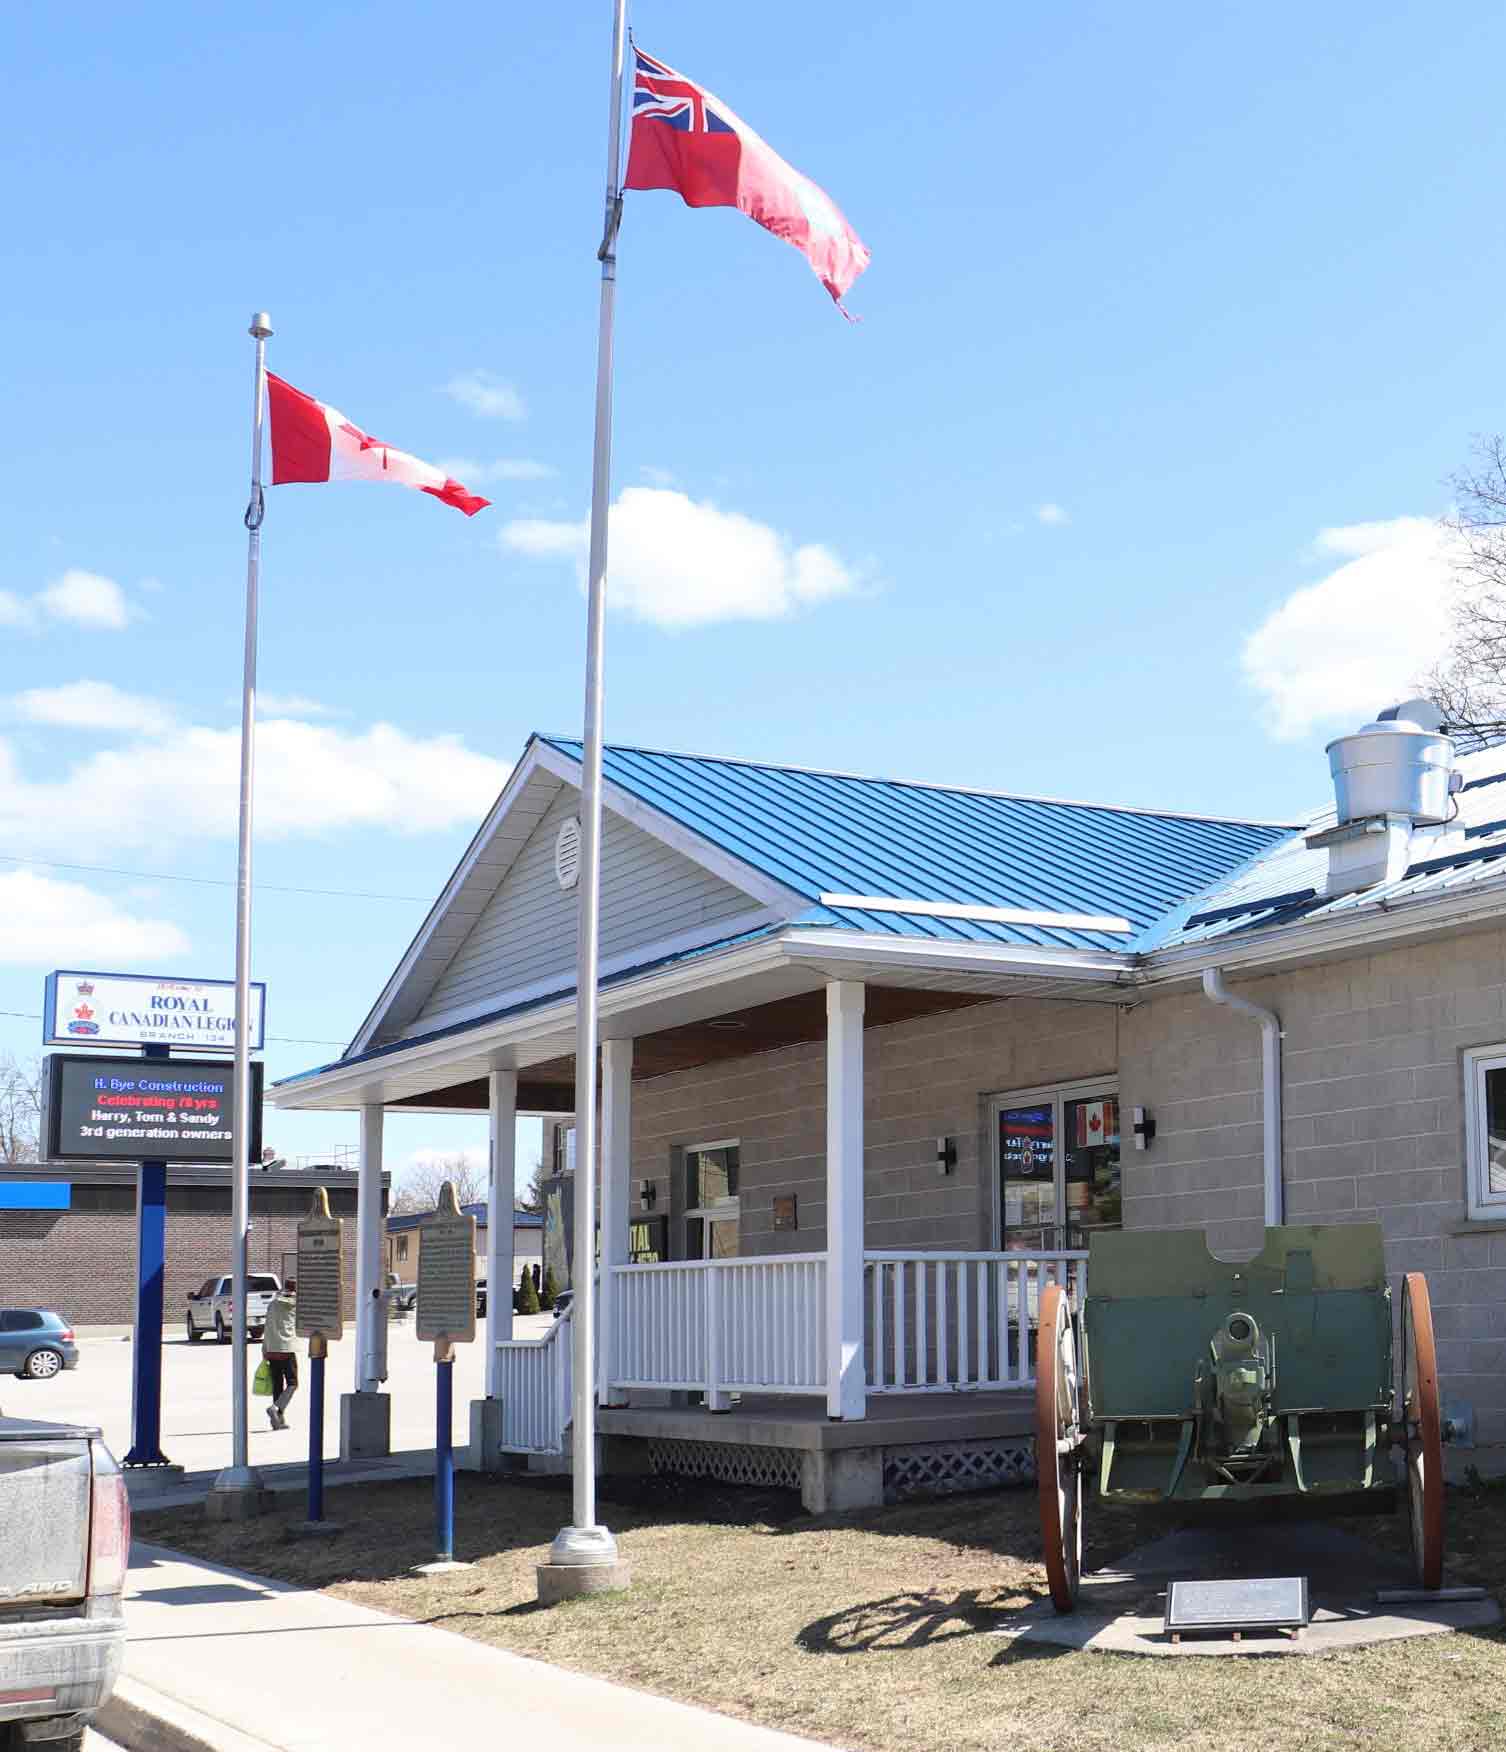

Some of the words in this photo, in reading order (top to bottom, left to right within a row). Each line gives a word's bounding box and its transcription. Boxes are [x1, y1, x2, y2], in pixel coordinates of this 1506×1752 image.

[151, 995, 213, 1012] ROYAL
[109, 1010, 193, 1029] CANADIAN
[197, 1015, 253, 1031] LEGI
[139, 1031, 194, 1040] BRANCH
[110, 1078, 135, 1091] Bye
[138, 1079, 224, 1093] Construction
[97, 1095, 176, 1110] Celebrating
[91, 1109, 132, 1124] Harry,
[135, 1110, 164, 1122] Tom
[166, 1112, 177, 1123] &
[179, 1112, 219, 1126] Sandy
[80, 1125, 103, 1137] 3rd
[106, 1127, 178, 1140] generation
[181, 1130, 232, 1140] owners
